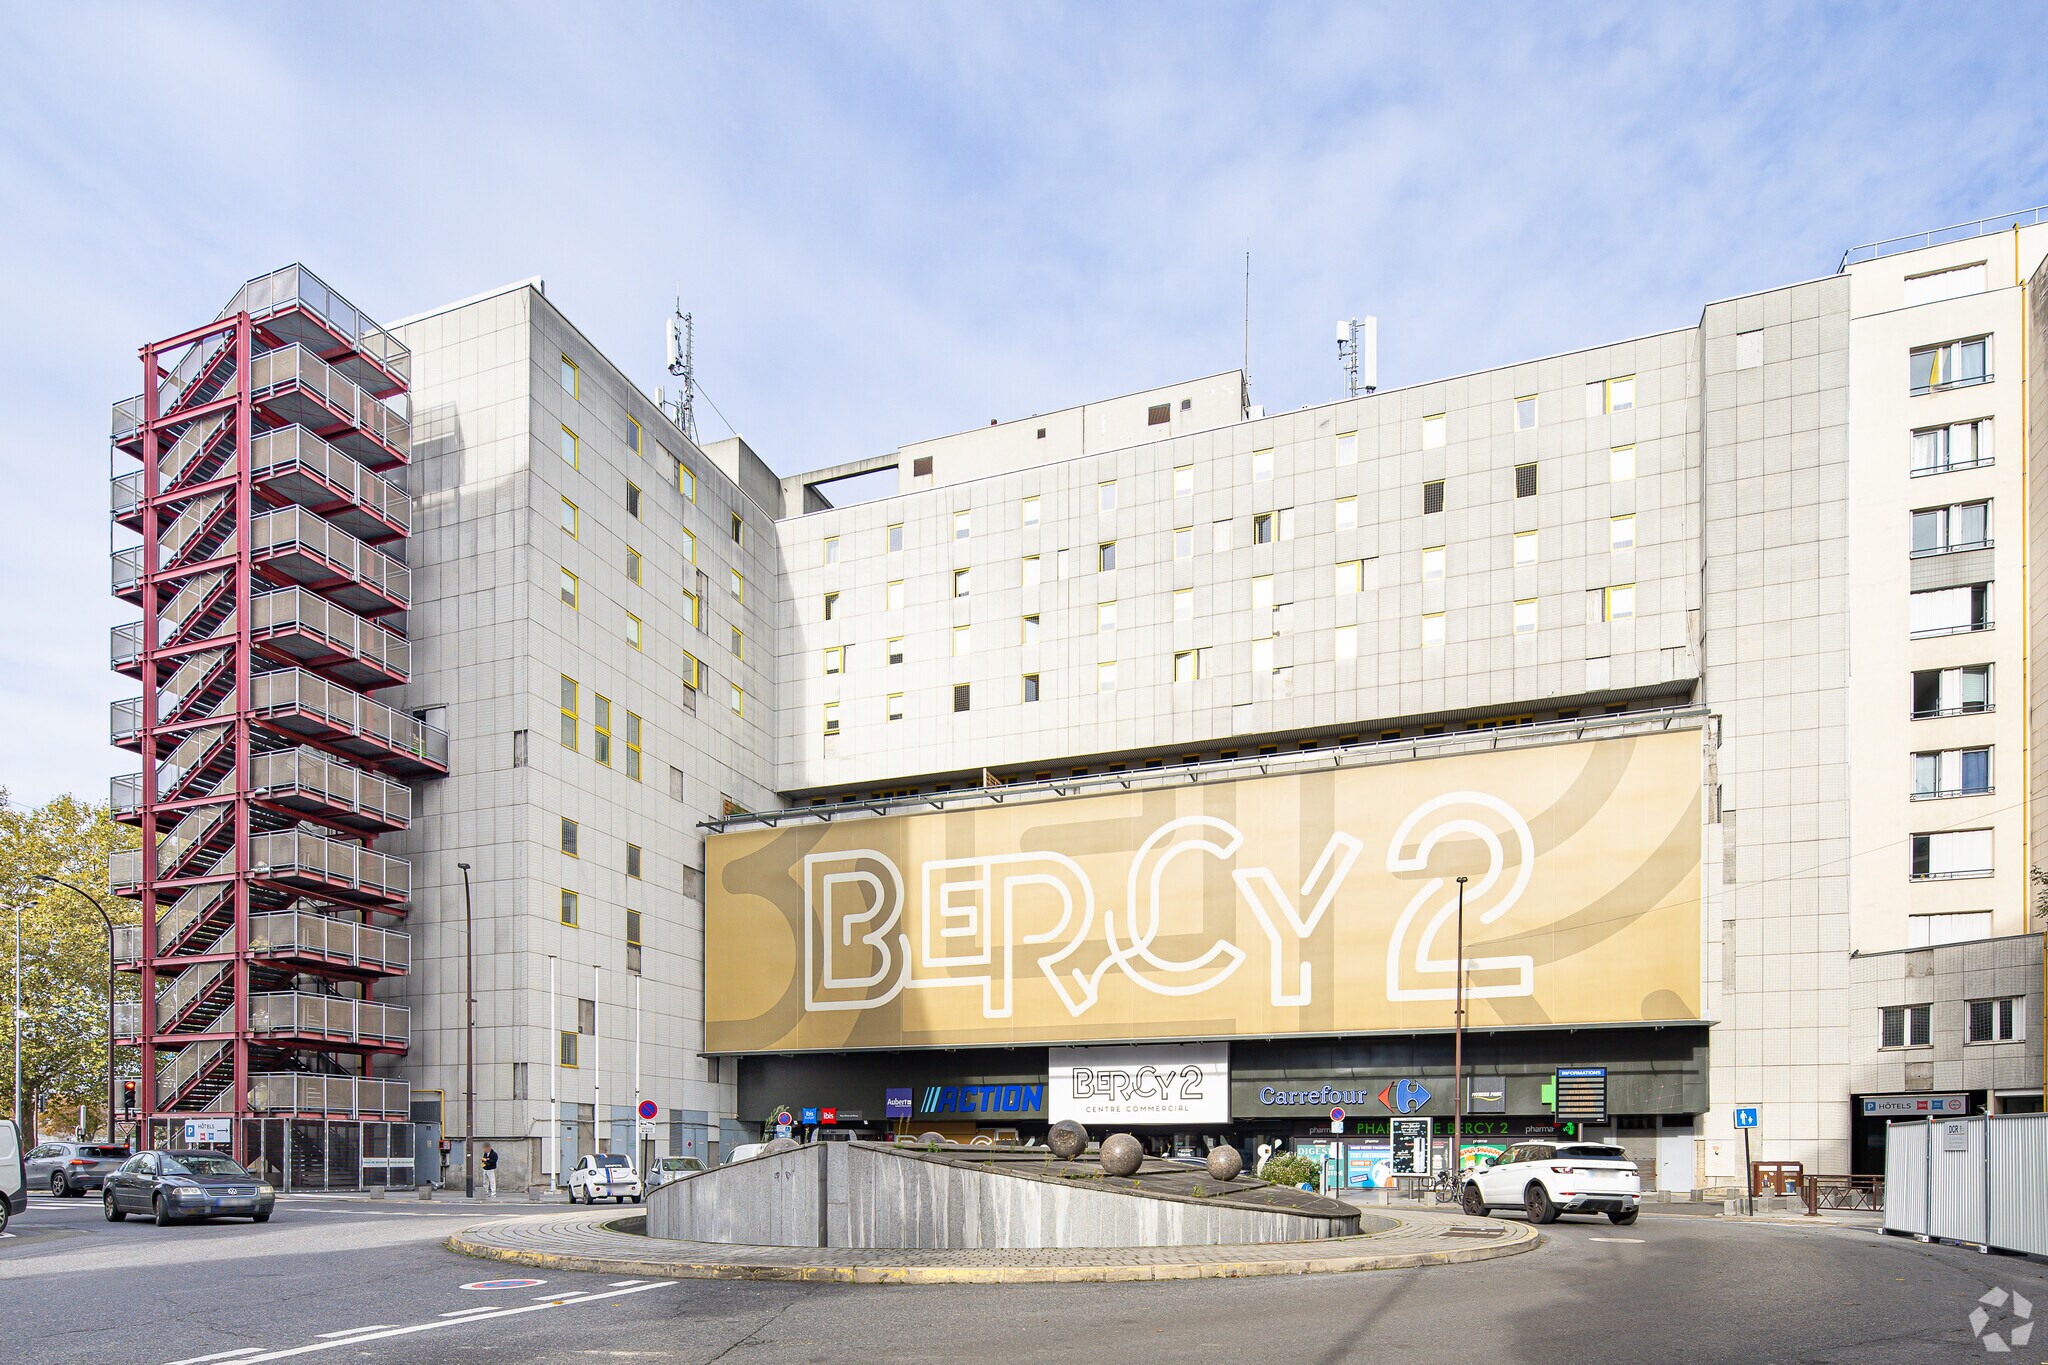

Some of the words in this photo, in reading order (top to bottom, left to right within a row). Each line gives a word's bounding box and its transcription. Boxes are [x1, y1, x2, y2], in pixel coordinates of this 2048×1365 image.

[804, 814, 1363, 1020] BERCY
[1386, 790, 1534, 1002] 2
[1073, 1065, 1176, 1101] BERCY
[1180, 1064, 1203, 1100] 2
[937, 1085, 1043, 1112] ACTION
[1260, 1085, 1367, 1105] Carrefour
[1879, 1102, 1912, 1110] HÔTELS
[1309, 1126, 1333, 1135] pharm
[1447, 1122, 1494, 1134] BERCY
[1500, 1122, 1508, 1134] 2
[1525, 1126, 1554, 1135] pharma
